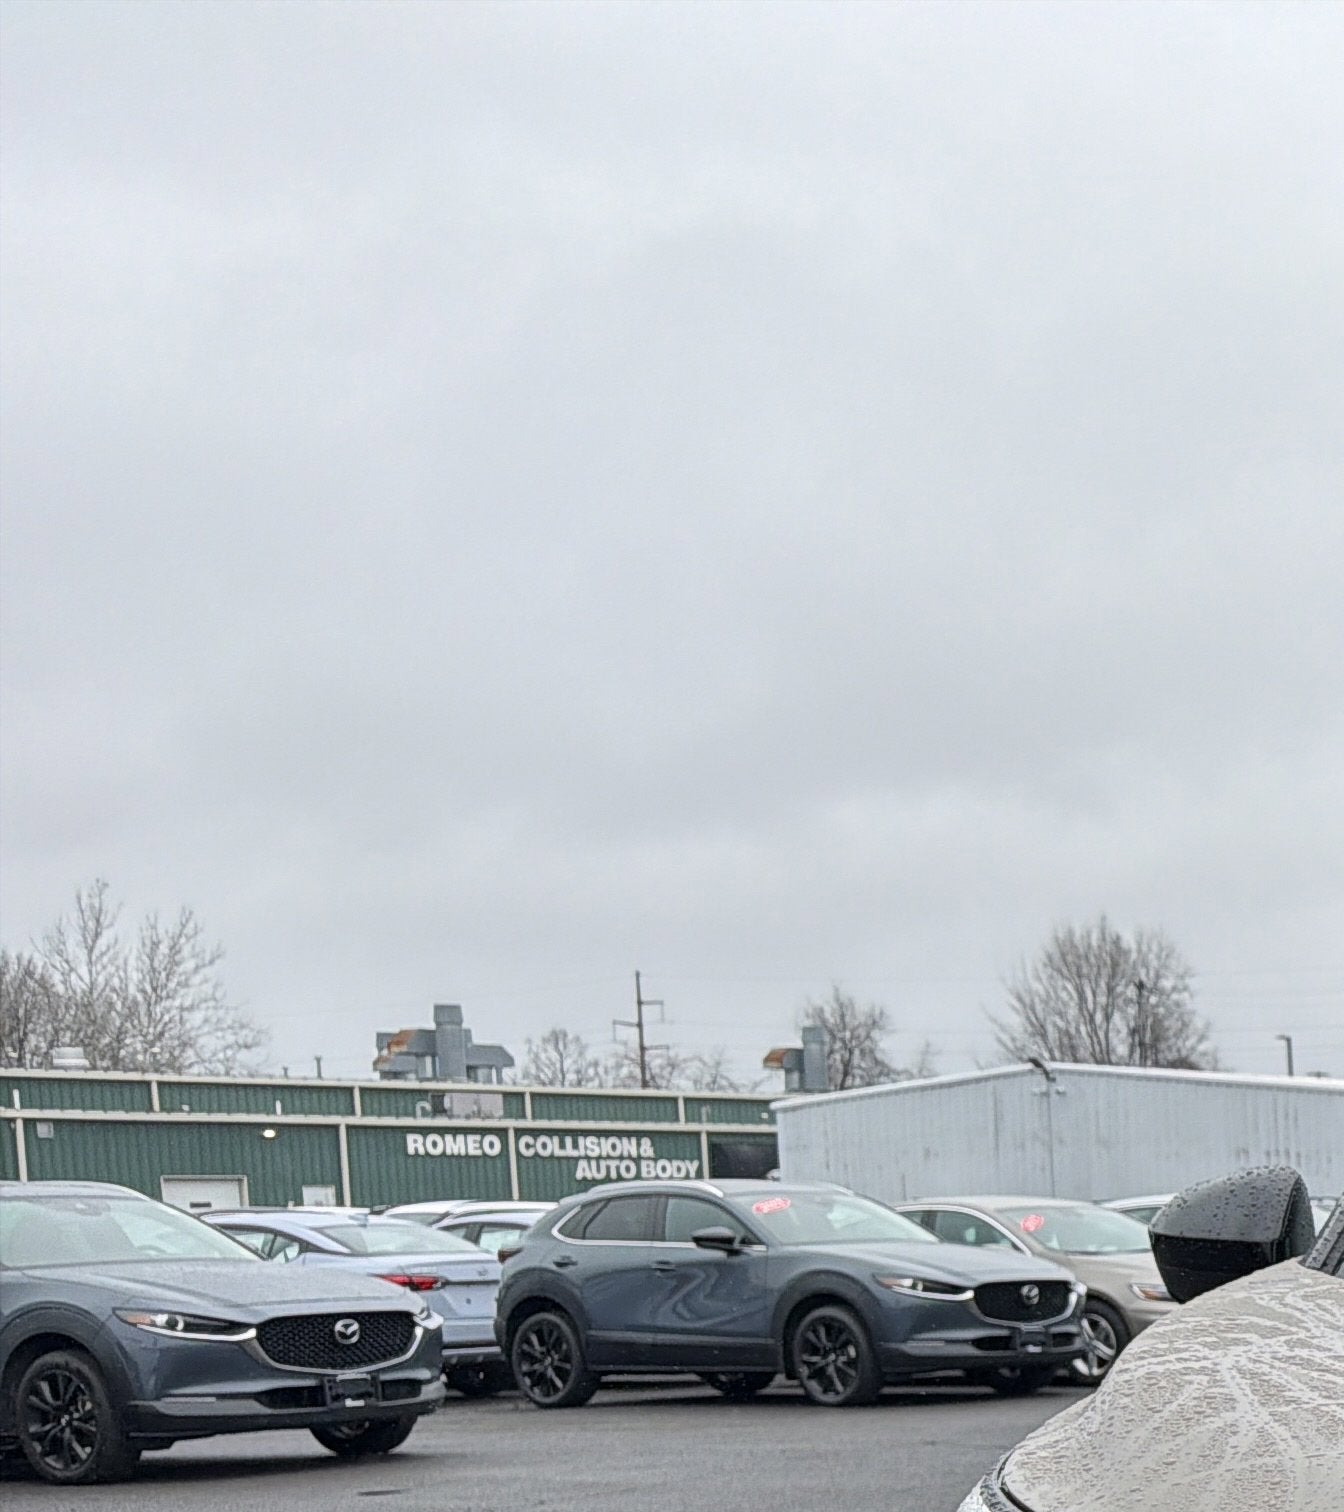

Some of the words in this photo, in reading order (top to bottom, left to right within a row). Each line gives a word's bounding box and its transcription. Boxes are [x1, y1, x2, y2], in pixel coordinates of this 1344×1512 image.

[406, 1133, 501, 1156] ROMEO
[518, 1135, 637, 1158] COLLISION
[639, 1137, 655, 1158] &
[575, 1159, 638, 1180] AUTO
[640, 1160, 700, 1179] BODY
